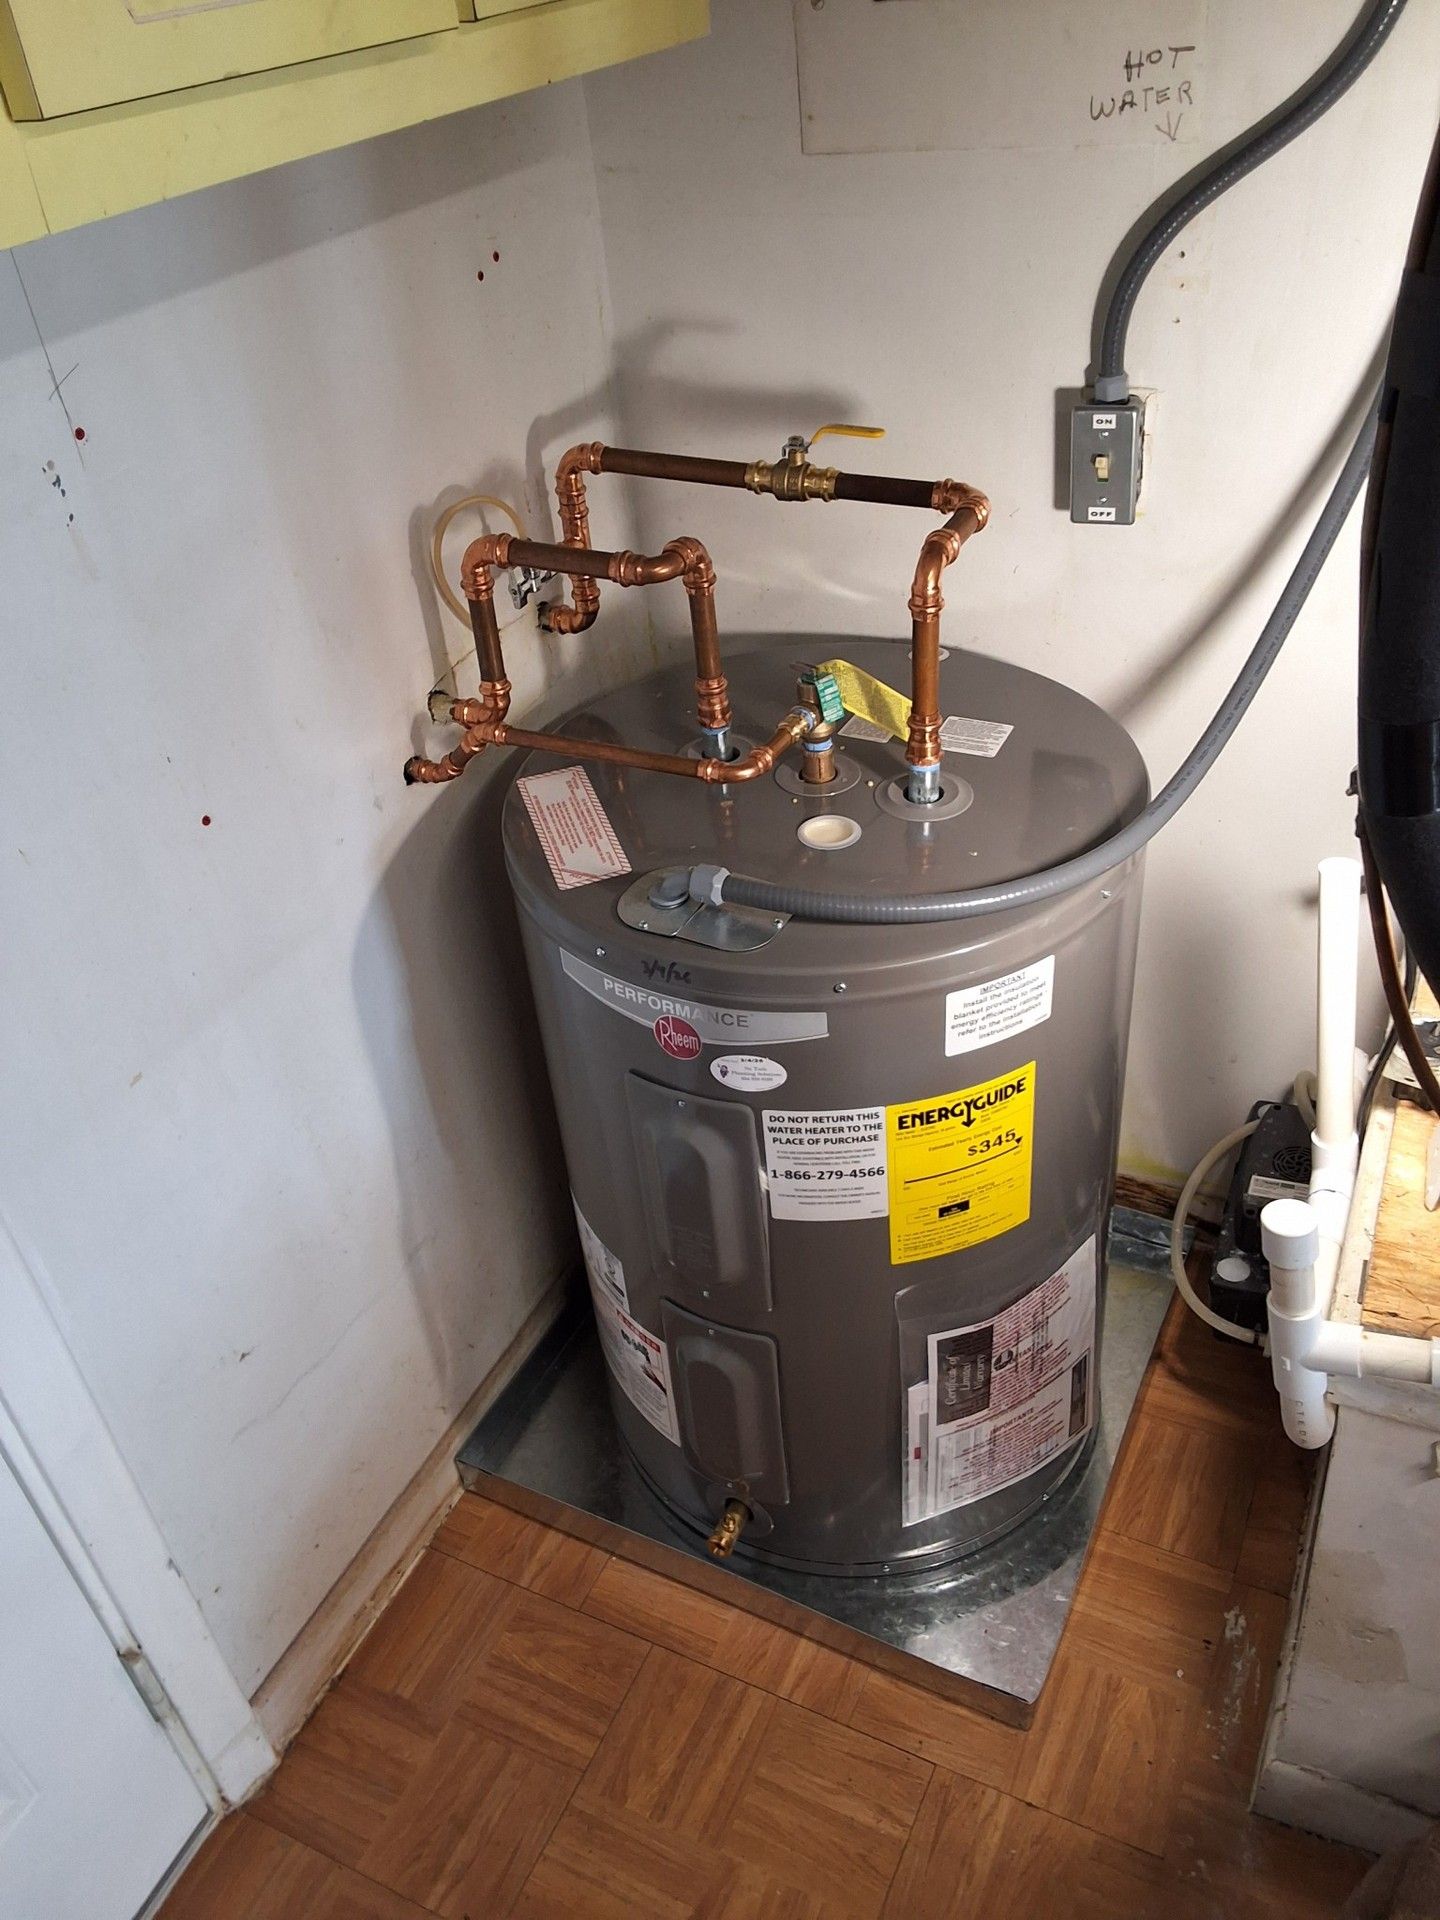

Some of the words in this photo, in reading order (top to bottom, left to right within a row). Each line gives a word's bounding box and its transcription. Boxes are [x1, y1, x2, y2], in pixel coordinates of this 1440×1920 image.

[1124, 46, 1196, 82] HOT
[1090, 80, 1193, 121] WATER
[980, 972, 1026, 995] IMPORTANT
[603, 977, 750, 1029] PERFORMANCE
[953, 1007, 984, 1020] blanket
[985, 994, 1019, 1012] provided
[963, 996, 988, 1008] Install
[990, 993, 1002, 1002] the
[658, 1015, 700, 1053] Rheem
[951, 1018, 979, 1030] energy
[957, 1027, 976, 1038] refer
[988, 1019, 1001, 1027] the
[978, 1019, 1024, 1039] instructions
[897, 1076, 1027, 1131] ENERGYGUIDE
[769, 1115, 785, 1124] DO
[787, 1115, 810, 1124] NOT
[811, 1114, 854, 1124] RETURN
[856, 1111, 880, 1120] THIS
[767, 1126, 803, 1135] WATER
[804, 1126, 845, 1135] HEATER
[847, 1124, 861, 1133] TO
[862, 1122, 884, 1131] THE
[772, 1136, 805, 1146] PLACE
[806, 1137, 822, 1146] OF
[823, 1133, 880, 1146] PURCHASE
[967, 1128, 1017, 1157] $345
[770, 1166, 886, 1181] 1-866-279-4566
[945, 1354, 961, 1365] of
[989, 1407, 1034, 1437] IMPORTANTE
